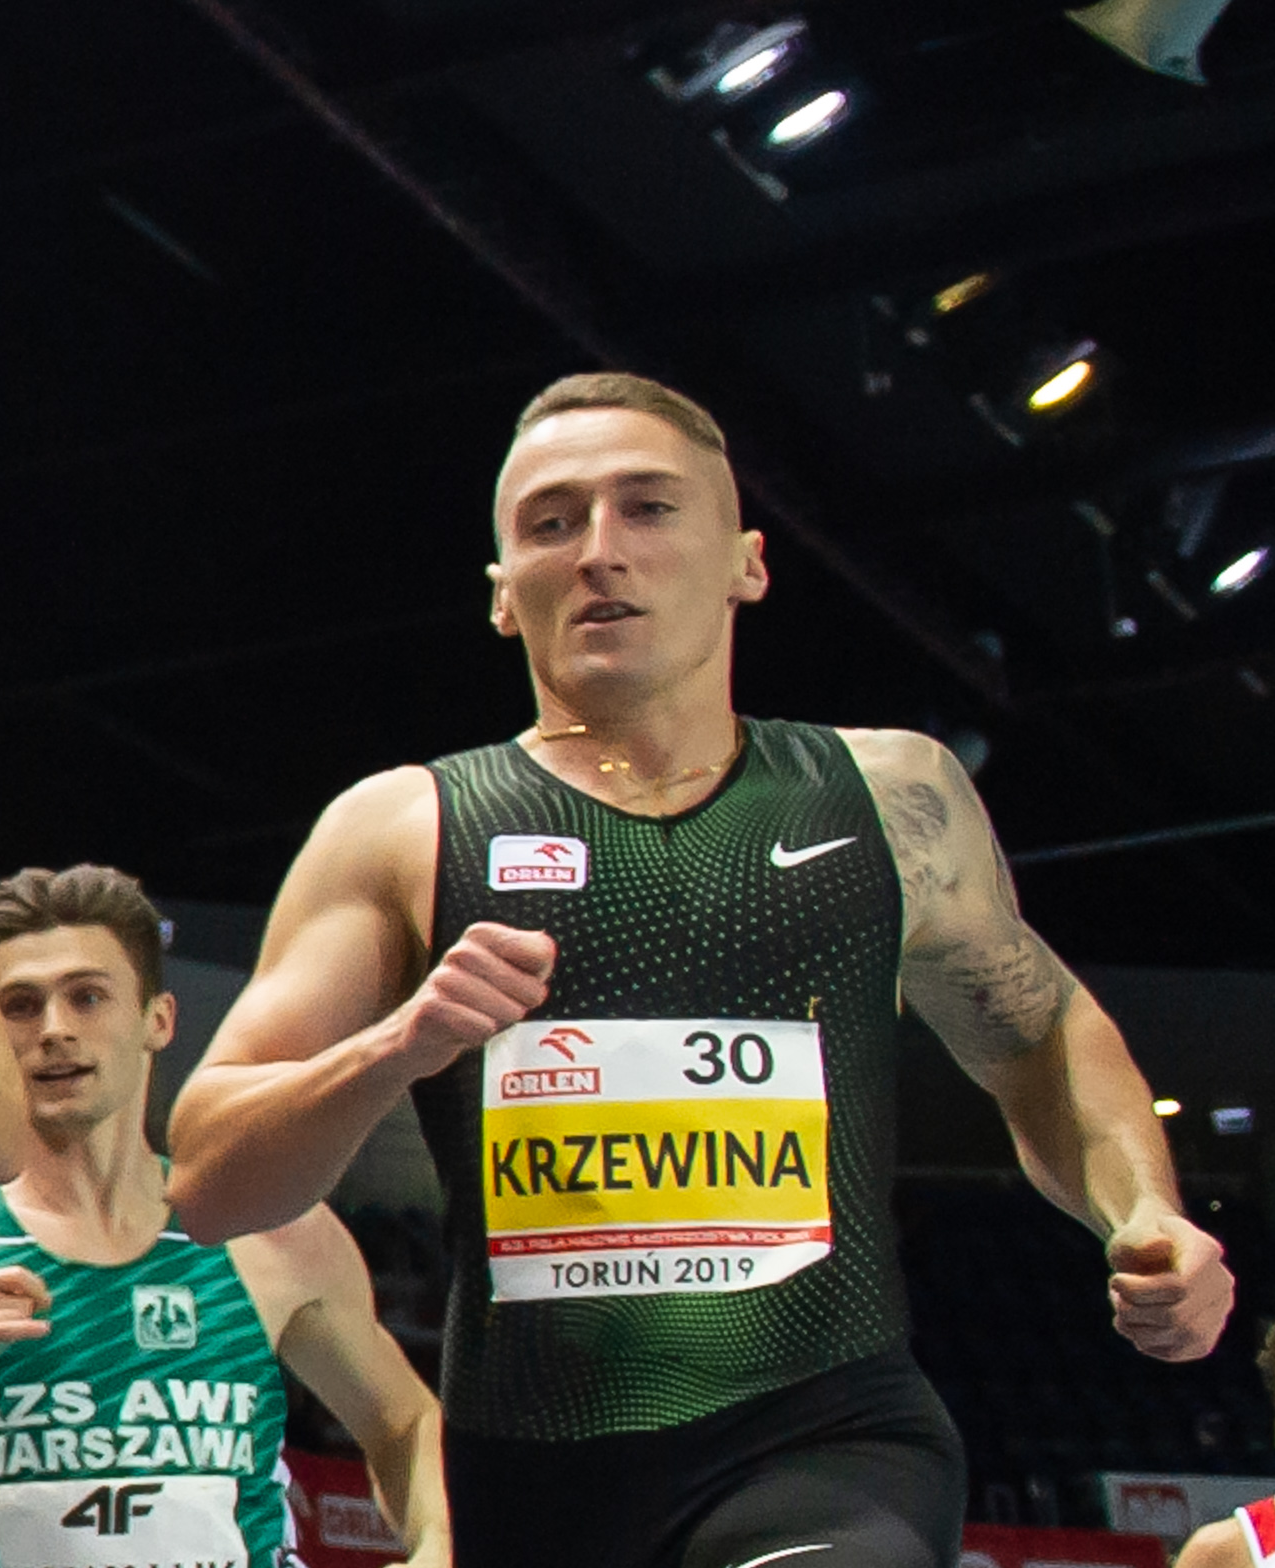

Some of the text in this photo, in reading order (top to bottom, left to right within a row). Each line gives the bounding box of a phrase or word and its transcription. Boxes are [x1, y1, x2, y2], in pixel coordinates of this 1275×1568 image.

[503, 867, 572, 881] ORLEN
[683, 1031, 774, 1086] 30
[503, 1070, 595, 1097] ORLEN
[491, 1130, 812, 1198] KRZEWINA
[551, 1251, 755, 1288] TORUŃ 2019
[119, 1378, 258, 1424] AWF
[61, 1482, 165, 1536] 4F
